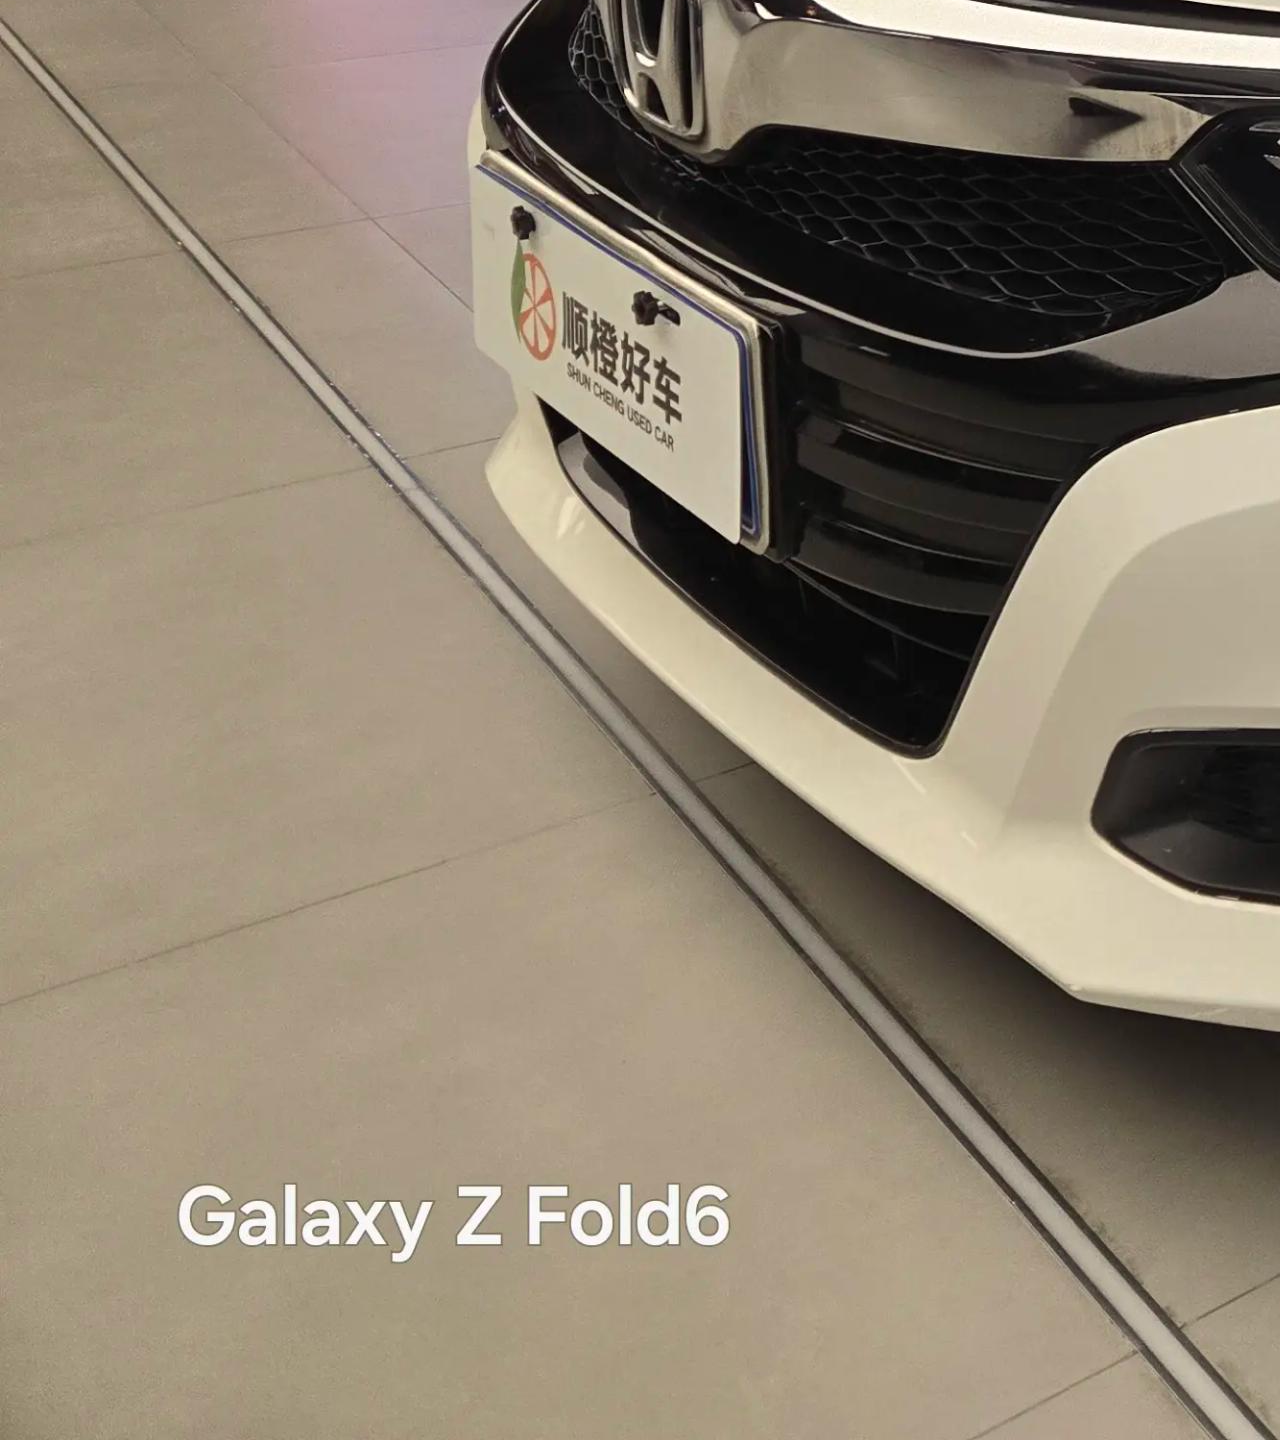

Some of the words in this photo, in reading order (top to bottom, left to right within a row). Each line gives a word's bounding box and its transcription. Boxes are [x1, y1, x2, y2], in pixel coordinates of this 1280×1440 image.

[561, 292, 683, 426] 顺橙好车
[567, 362, 592, 392] SHUN
[593, 382, 625, 417] CHENG
[627, 404, 653, 435] USED
[654, 425, 675, 453] CAR
